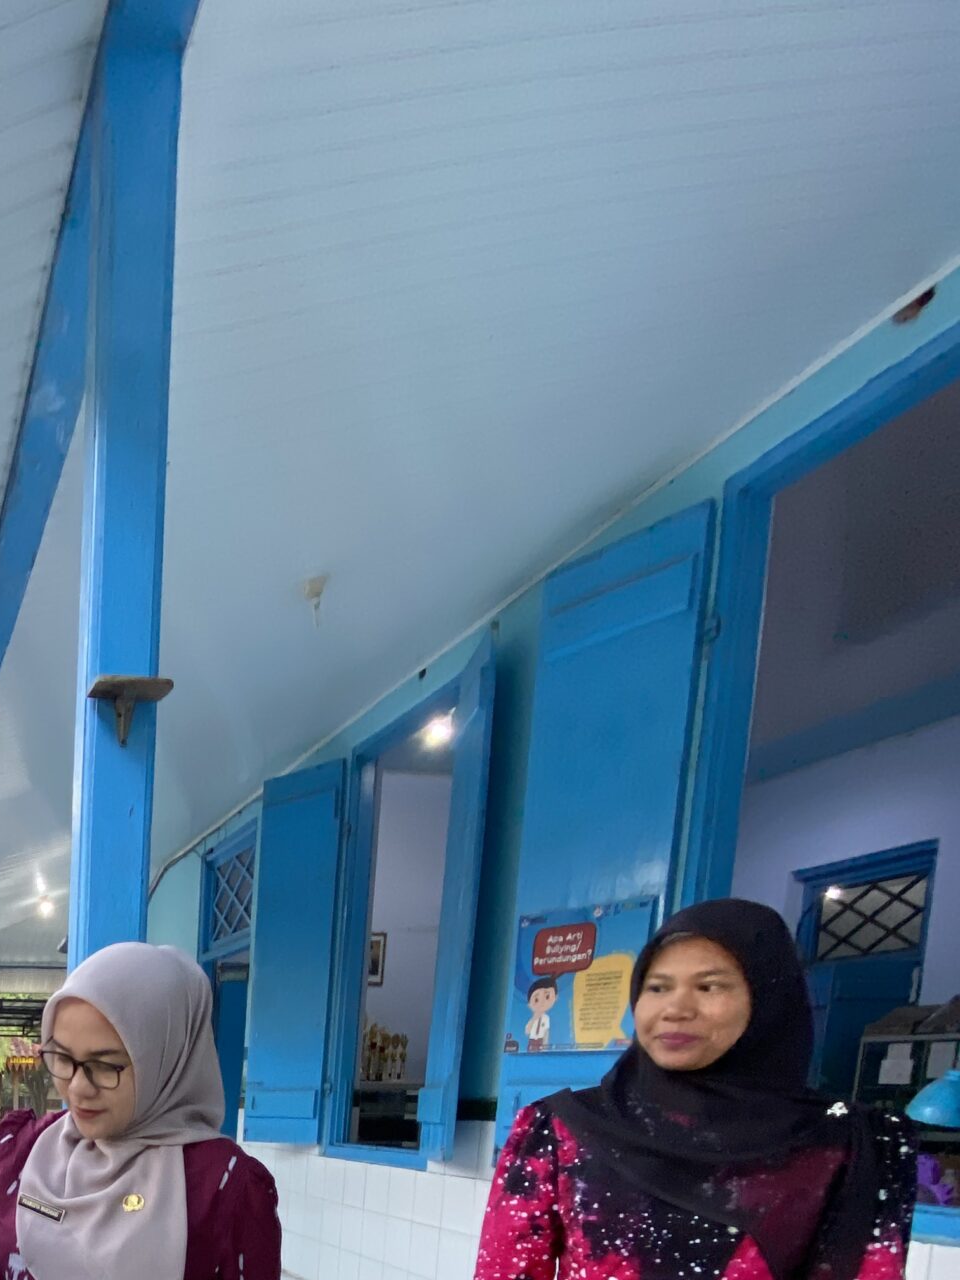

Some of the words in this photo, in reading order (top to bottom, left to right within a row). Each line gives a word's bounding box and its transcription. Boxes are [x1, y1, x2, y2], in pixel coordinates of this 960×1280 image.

[547, 935, 563, 943] Apa
[566, 931, 583, 940] Arti
[534, 949, 592, 965] Perundungan?
